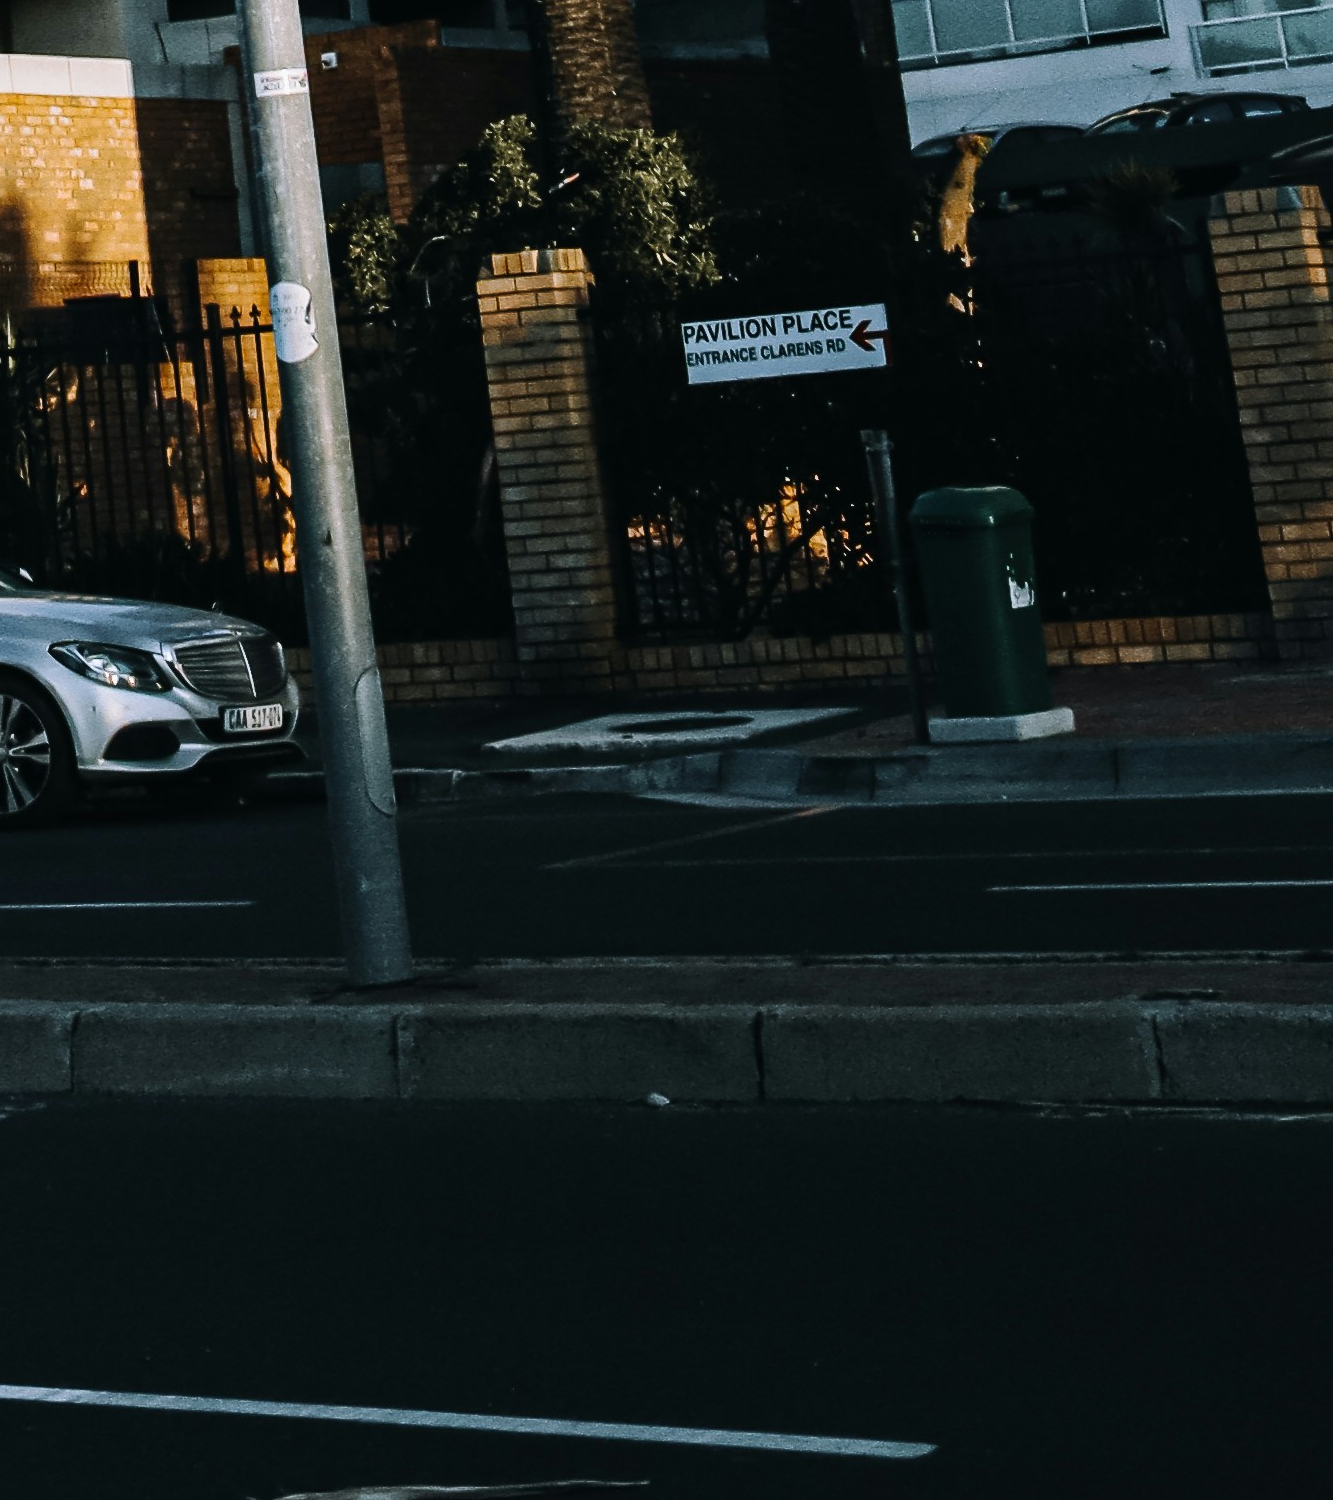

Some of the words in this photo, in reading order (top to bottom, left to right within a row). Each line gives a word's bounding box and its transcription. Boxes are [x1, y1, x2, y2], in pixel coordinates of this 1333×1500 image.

[683, 316, 777, 344] PAVILION
[781, 309, 854, 335] PLACE
[686, 346, 758, 367] ENTRANCE
[760, 340, 824, 360] CLARENS
[825, 337, 846, 354] RD
